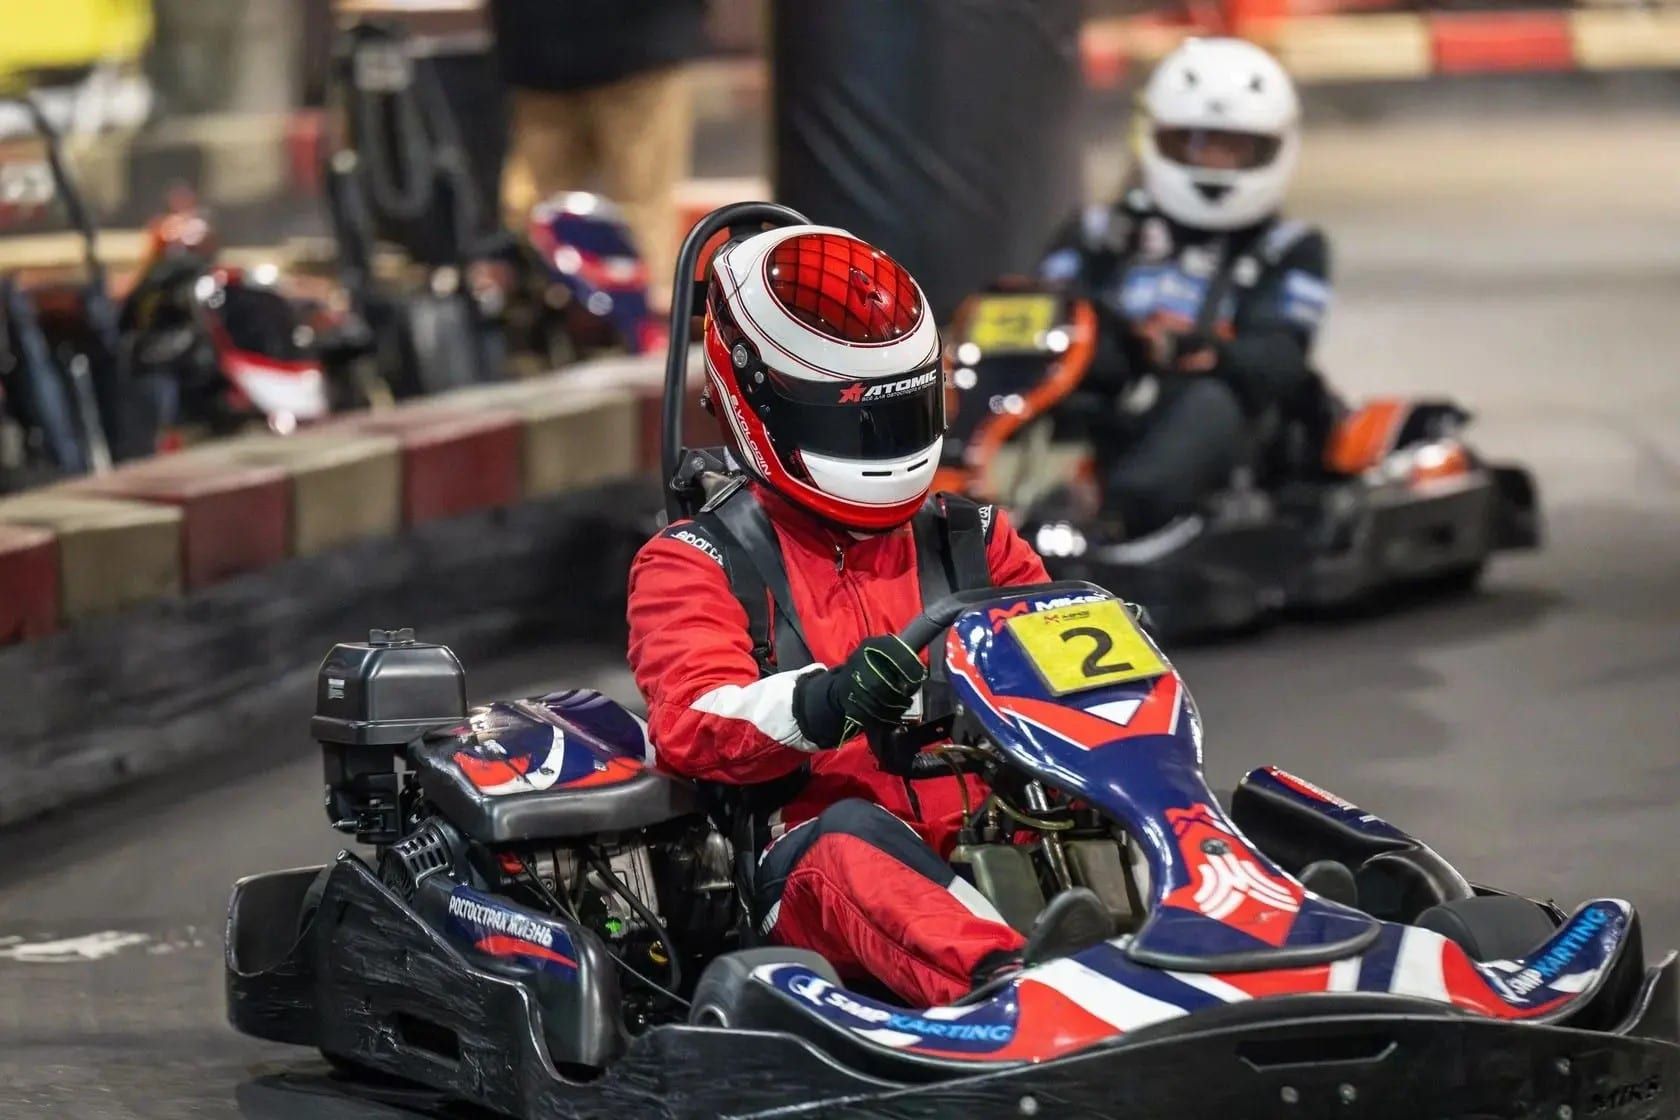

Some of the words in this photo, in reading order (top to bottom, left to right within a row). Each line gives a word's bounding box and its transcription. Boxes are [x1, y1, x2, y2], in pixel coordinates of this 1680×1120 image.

[864, 369, 937, 397] ATOMIC
[1059, 627, 1134, 678] 2
[506, 912, 553, 947] ЖИЗНЬ
